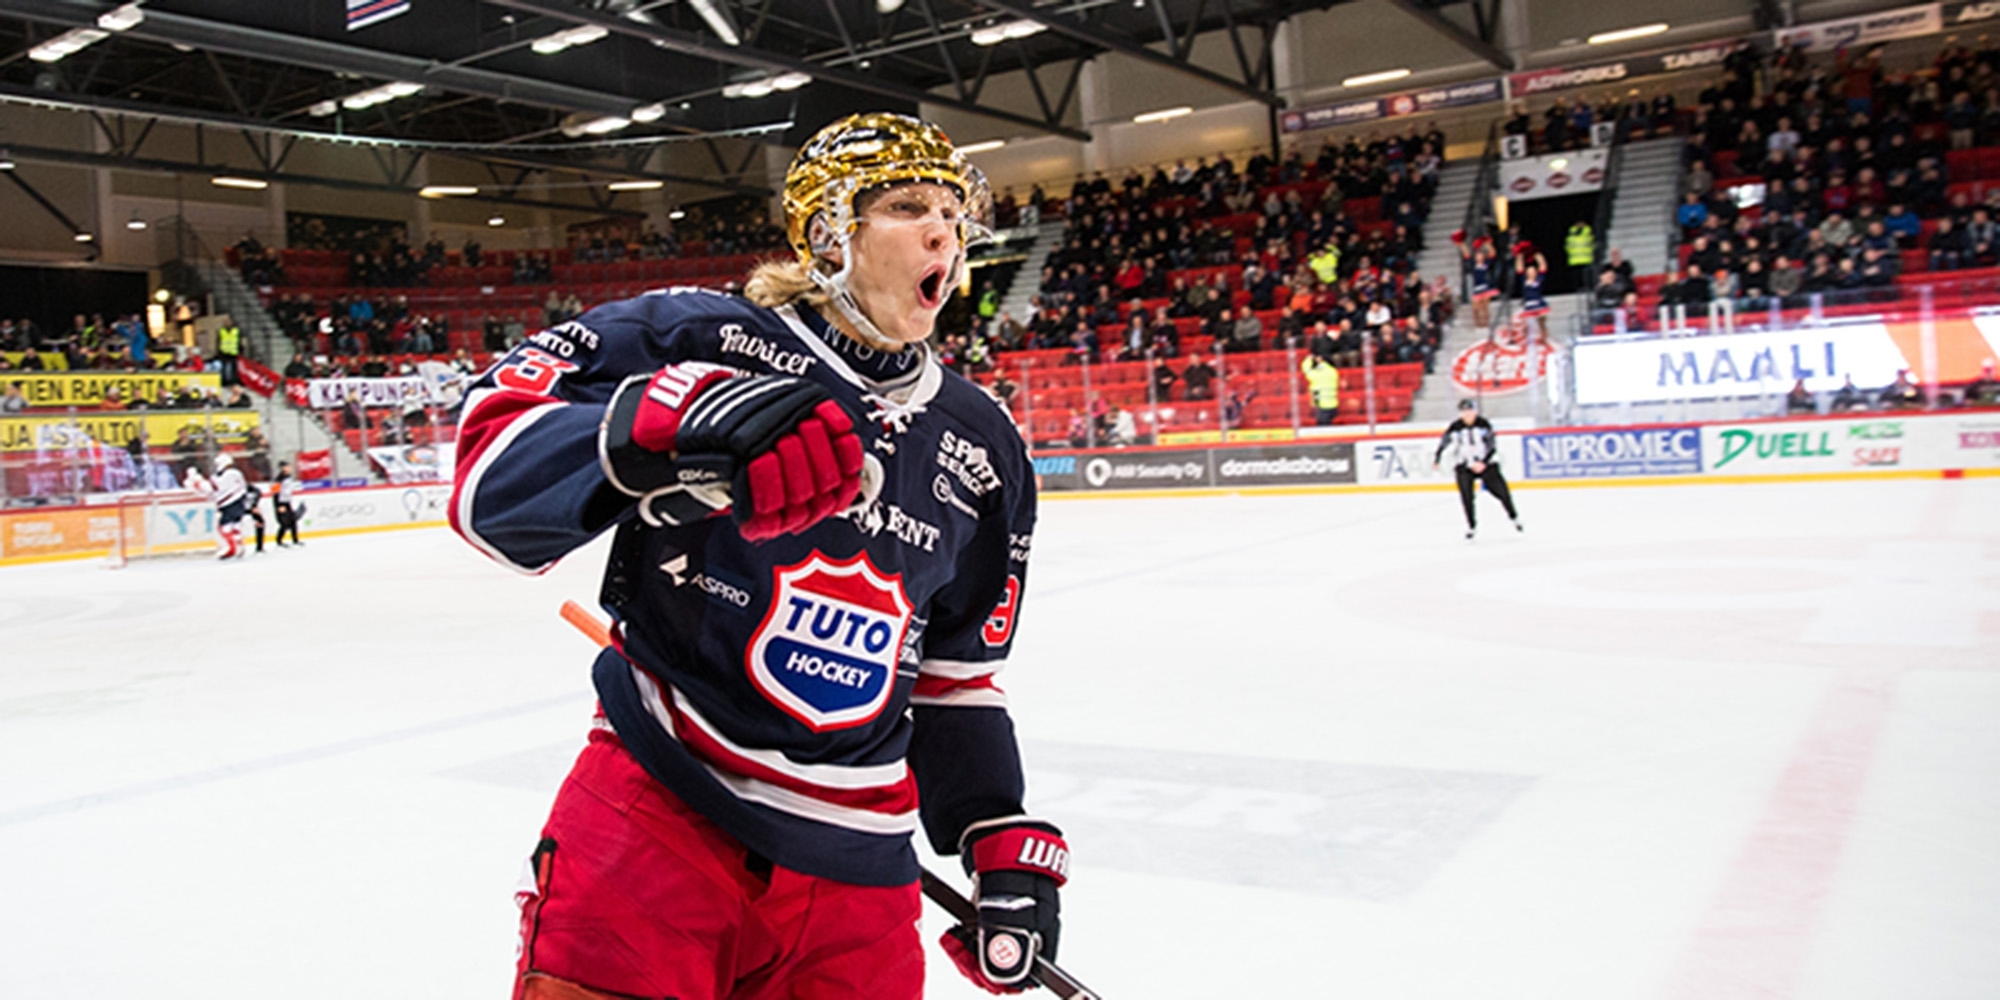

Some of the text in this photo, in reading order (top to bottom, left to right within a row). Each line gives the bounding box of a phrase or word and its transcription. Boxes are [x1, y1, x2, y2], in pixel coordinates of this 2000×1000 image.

[1657, 342, 1835, 386] MAALI
[2, 426, 33, 448] JA
[1526, 430, 1697, 462] NIPROMEC
[690, 572, 751, 607] ASPRO
[786, 596, 892, 655] TUTO
[785, 651, 872, 690] HOCKEY
